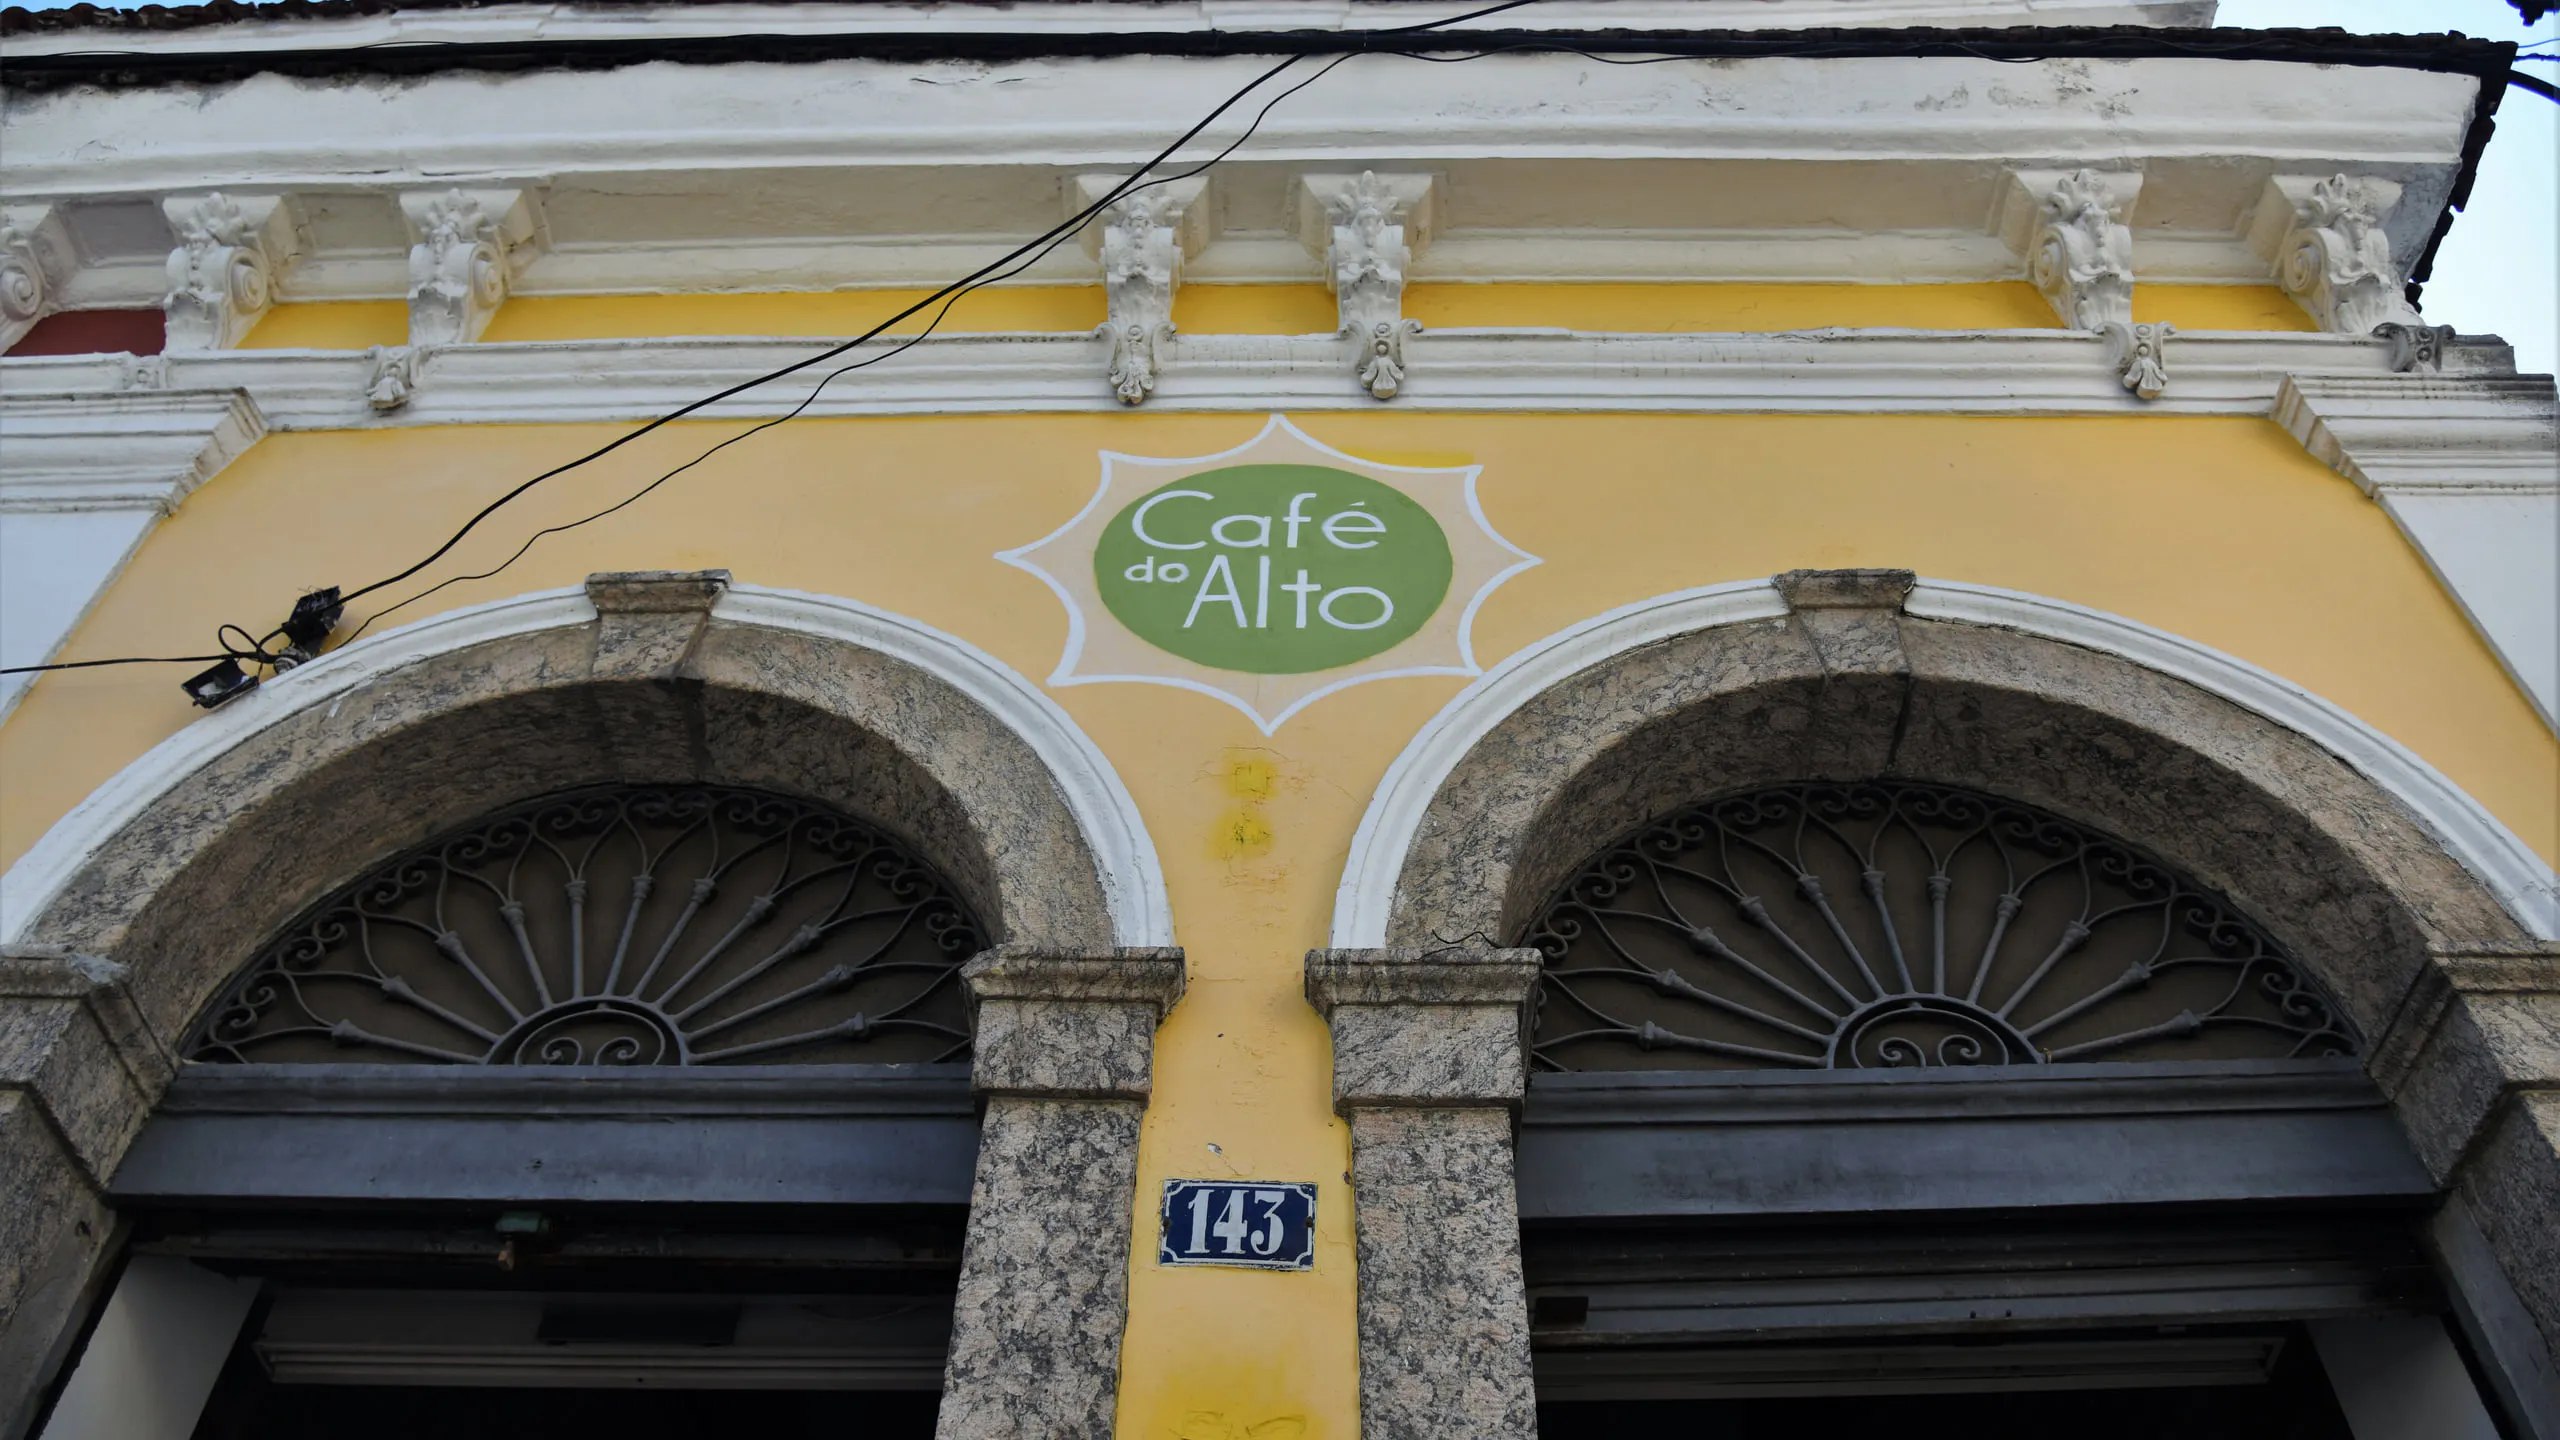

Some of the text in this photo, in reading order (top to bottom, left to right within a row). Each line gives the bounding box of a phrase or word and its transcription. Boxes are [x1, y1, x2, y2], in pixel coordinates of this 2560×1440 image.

[1131, 489, 1387, 549] Café
[1124, 554, 1394, 630] do Alto
[1184, 1189, 1286, 1255] 143
